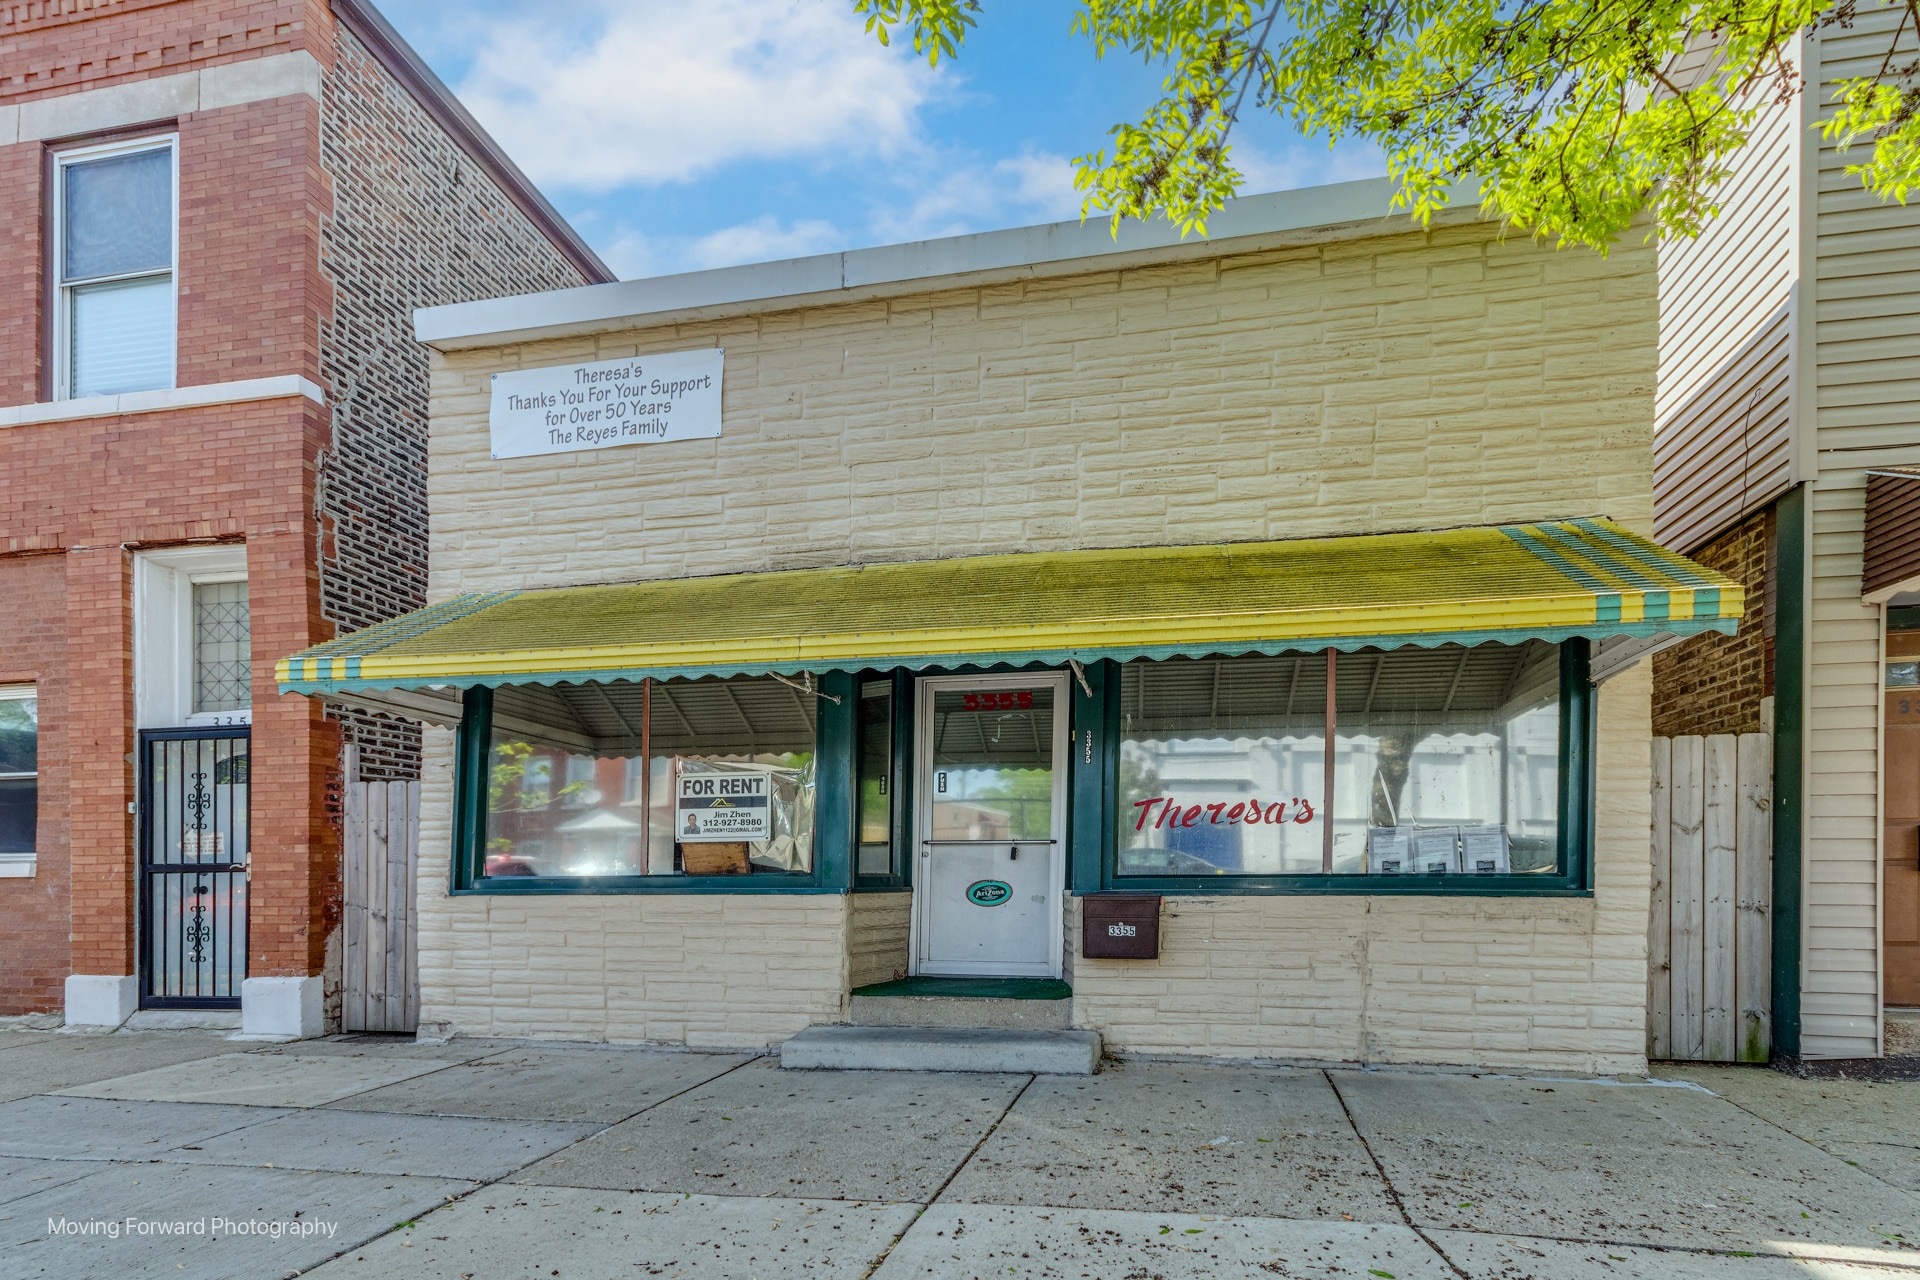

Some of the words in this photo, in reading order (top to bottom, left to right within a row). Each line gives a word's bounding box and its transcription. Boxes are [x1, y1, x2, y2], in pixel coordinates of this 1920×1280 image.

[574, 362, 643, 385] Theresa's
[508, 391, 556, 411] Thanks
[560, 388, 585, 406] You
[588, 386, 611, 402] For
[615, 382, 647, 399] Your
[651, 374, 712, 399] Support
[545, 411, 566, 427] for
[570, 408, 602, 424] Over
[605, 402, 626, 419] 50
[630, 400, 672, 417] Years
[549, 428, 572, 445] The
[576, 426, 618, 445] Reyes
[622, 418, 669, 438] Family
[962, 691, 1033, 711] 3355
[683, 779, 714, 795] FOR
[720, 778, 763, 794] RENT
[703, 818, 762, 827] 312-927-8980
[713, 811, 728, 819] Jim
[729, 810, 751, 818] Zhen
[1134, 797, 1316, 831] Theresa's
[1109, 926, 1135, 936] 3355
